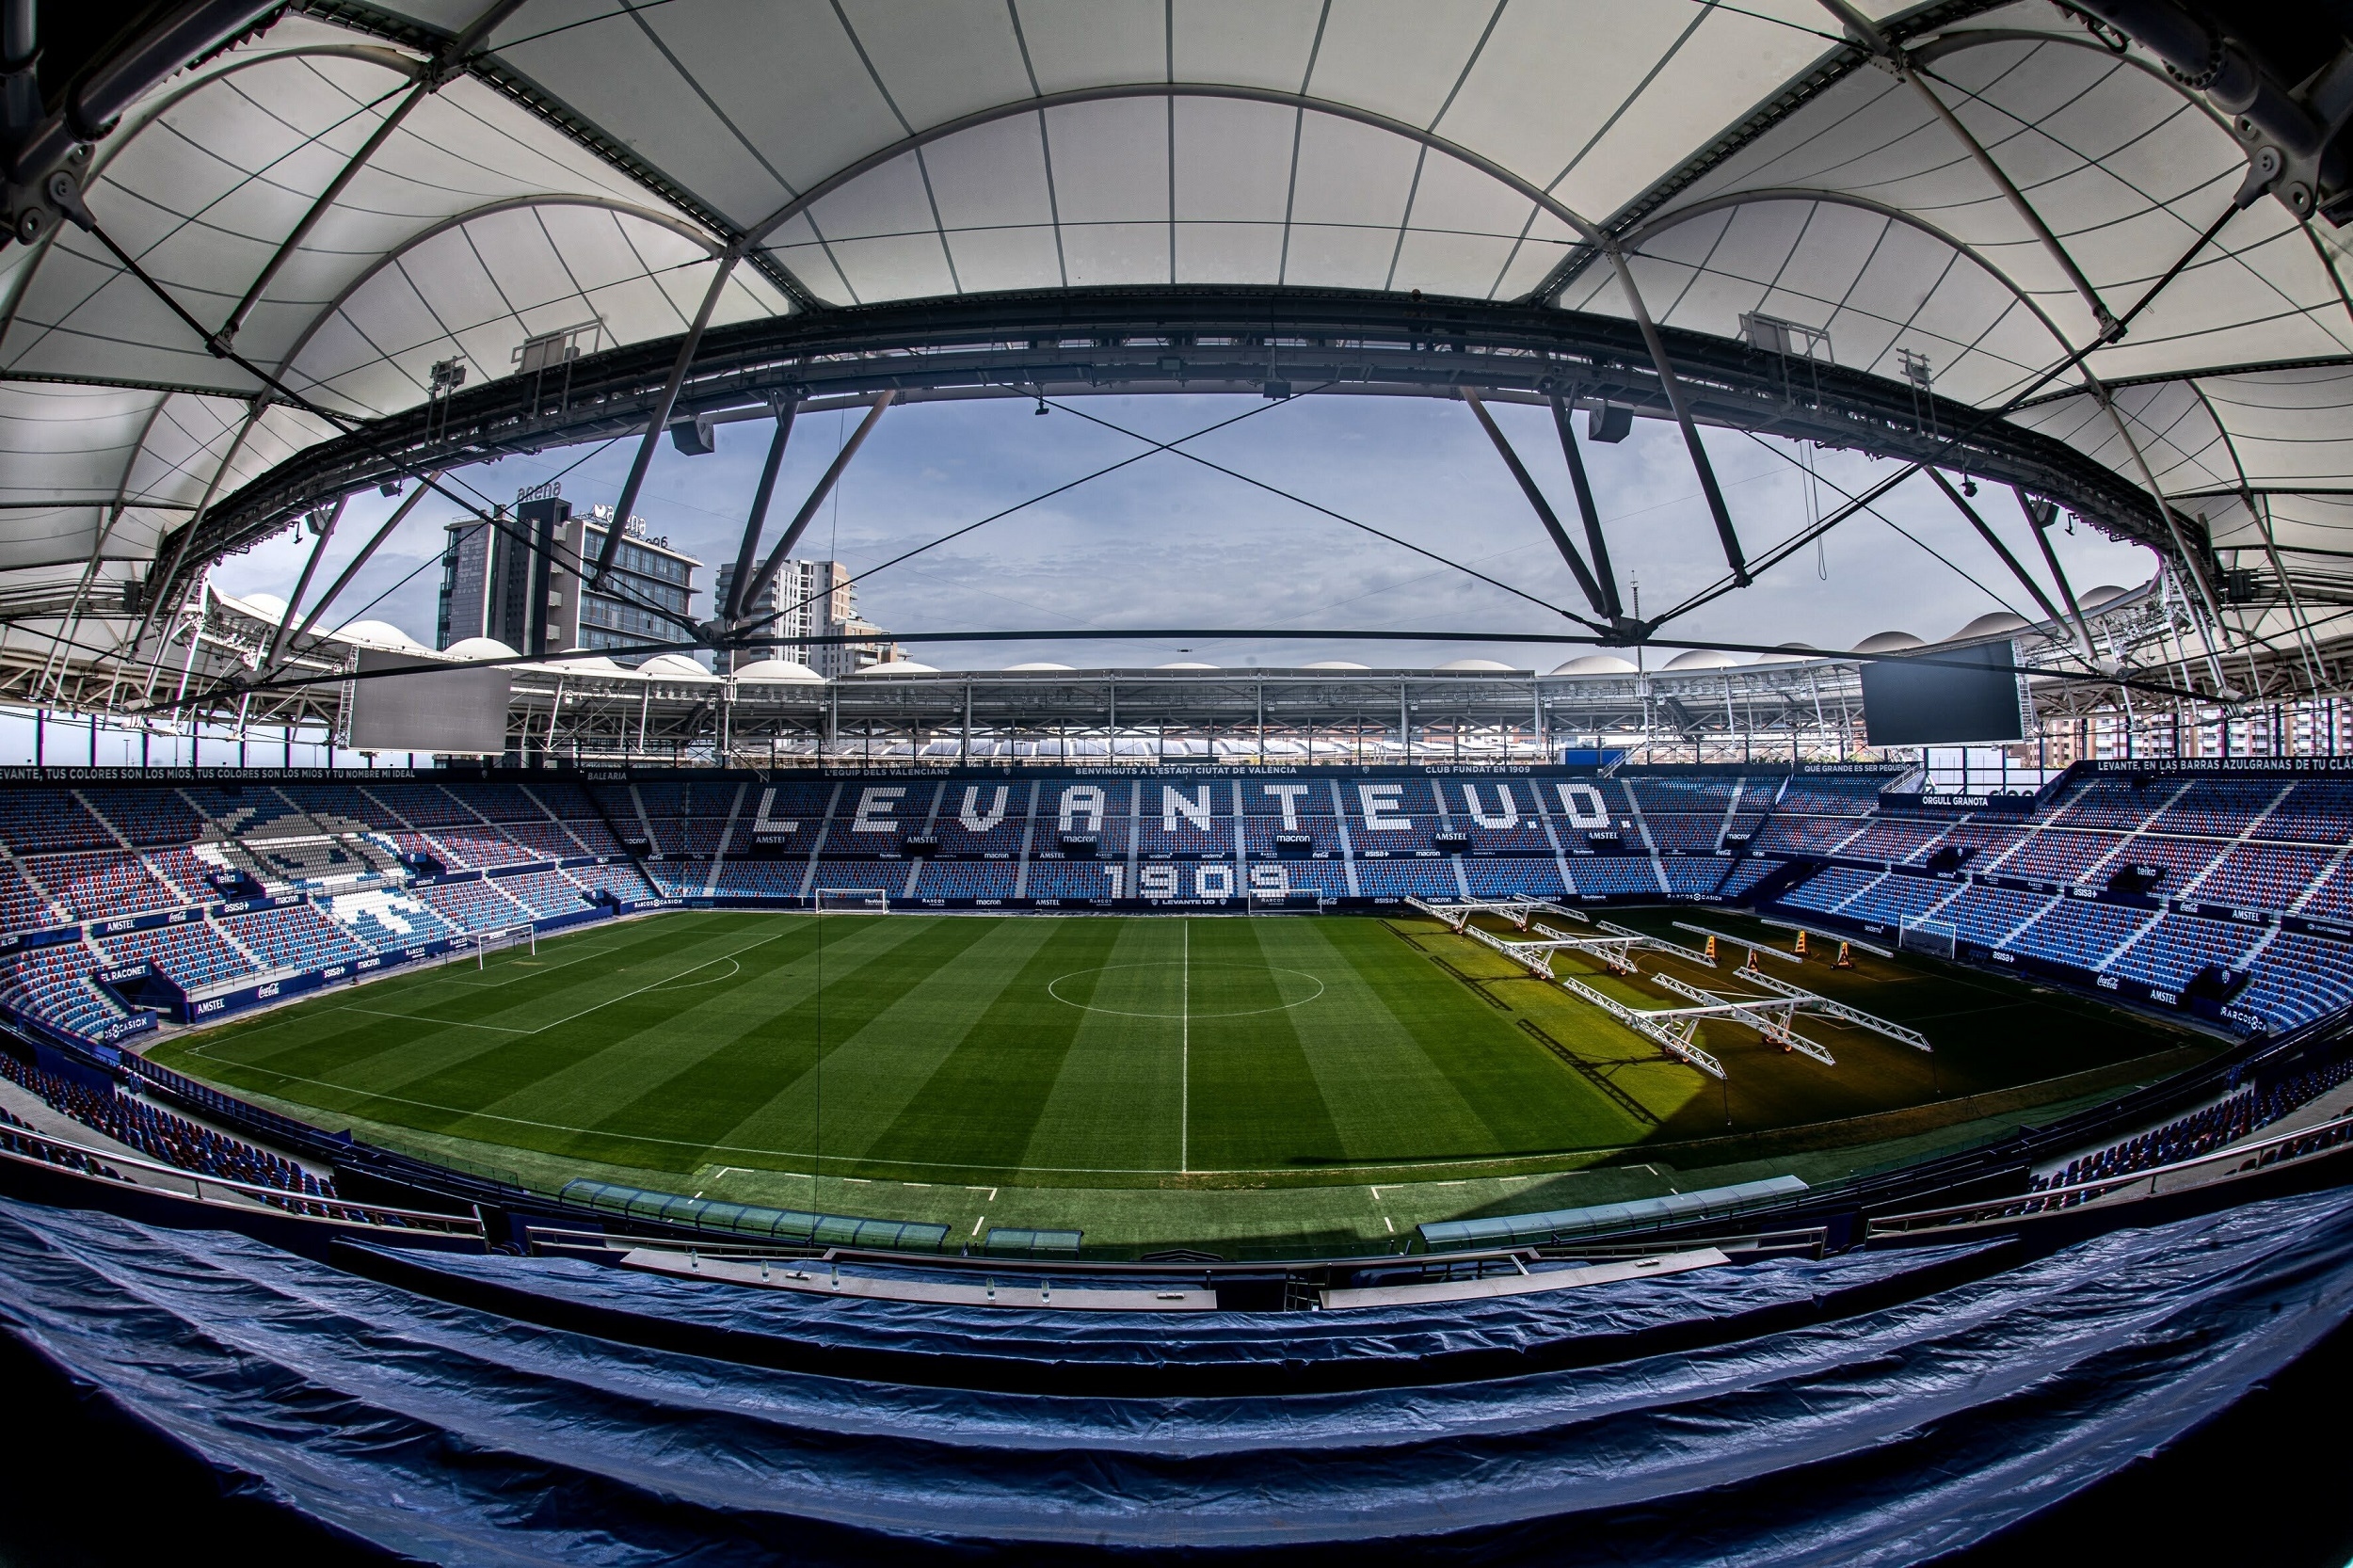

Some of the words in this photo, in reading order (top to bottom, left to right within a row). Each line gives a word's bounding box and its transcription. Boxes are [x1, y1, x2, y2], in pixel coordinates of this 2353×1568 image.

[517, 481, 562, 503] arena
[607, 505, 647, 536] ana
[1075, 767, 1138, 776] BENVINGUTS
[1195, 766, 1230, 775] CIUTAT
[1232, 766, 1246, 775] DE
[1425, 766, 1450, 775] CLUB
[1821, 764, 1853, 773] GRANDE
[2098, 760, 2141, 772] LEVANTE,
[2144, 761, 2156, 770] EN
[2159, 760, 2178, 770] LAS
[2180, 760, 2219, 770] BARRAS
[2222, 760, 2292, 770] AZULGRANAS
[2295, 759, 2310, 770] DE
[2312, 759, 2327, 770] TU
[46, 768, 67, 779] TUS
[70, 768, 118, 779] COLORES
[121, 768, 142, 779] SON
[145, 768, 165, 779] LOS
[197, 769, 215, 778] TUS
[217, 769, 260, 779] COLORES
[262, 769, 280, 778] SON
[282, 769, 299, 778] LOS
[325, 769, 330, 778] Y
[333, 769, 344, 778] TU
[345, 769, 380, 778] NOMBRE
[381, 769, 391, 778] MI
[392, 769, 415, 778] IDEAL
[824, 768, 861, 777] L'EQUIP
[863, 768, 887, 776] DELS
[889, 768, 951, 776] VALENCIANS
[1922, 796, 1950, 806] ORGULL
[1952, 796, 1989, 807] GRANOTA
[1063, 835, 1097, 843] macron
[1276, 835, 1310, 843] macron
[216, 872, 235, 884] teika
[1103, 865, 1289, 899] 1909
[275, 894, 299, 905] macron
[2232, 909, 2261, 922] AMSTEL
[106, 919, 136, 932] AMSTEL
[357, 958, 380, 969] macron
[101, 972, 111, 983] EL
[111, 965, 147, 981] RACONET
[2150, 989, 2177, 1005] AMSTEL
[198, 999, 226, 1015] AMSTEL
